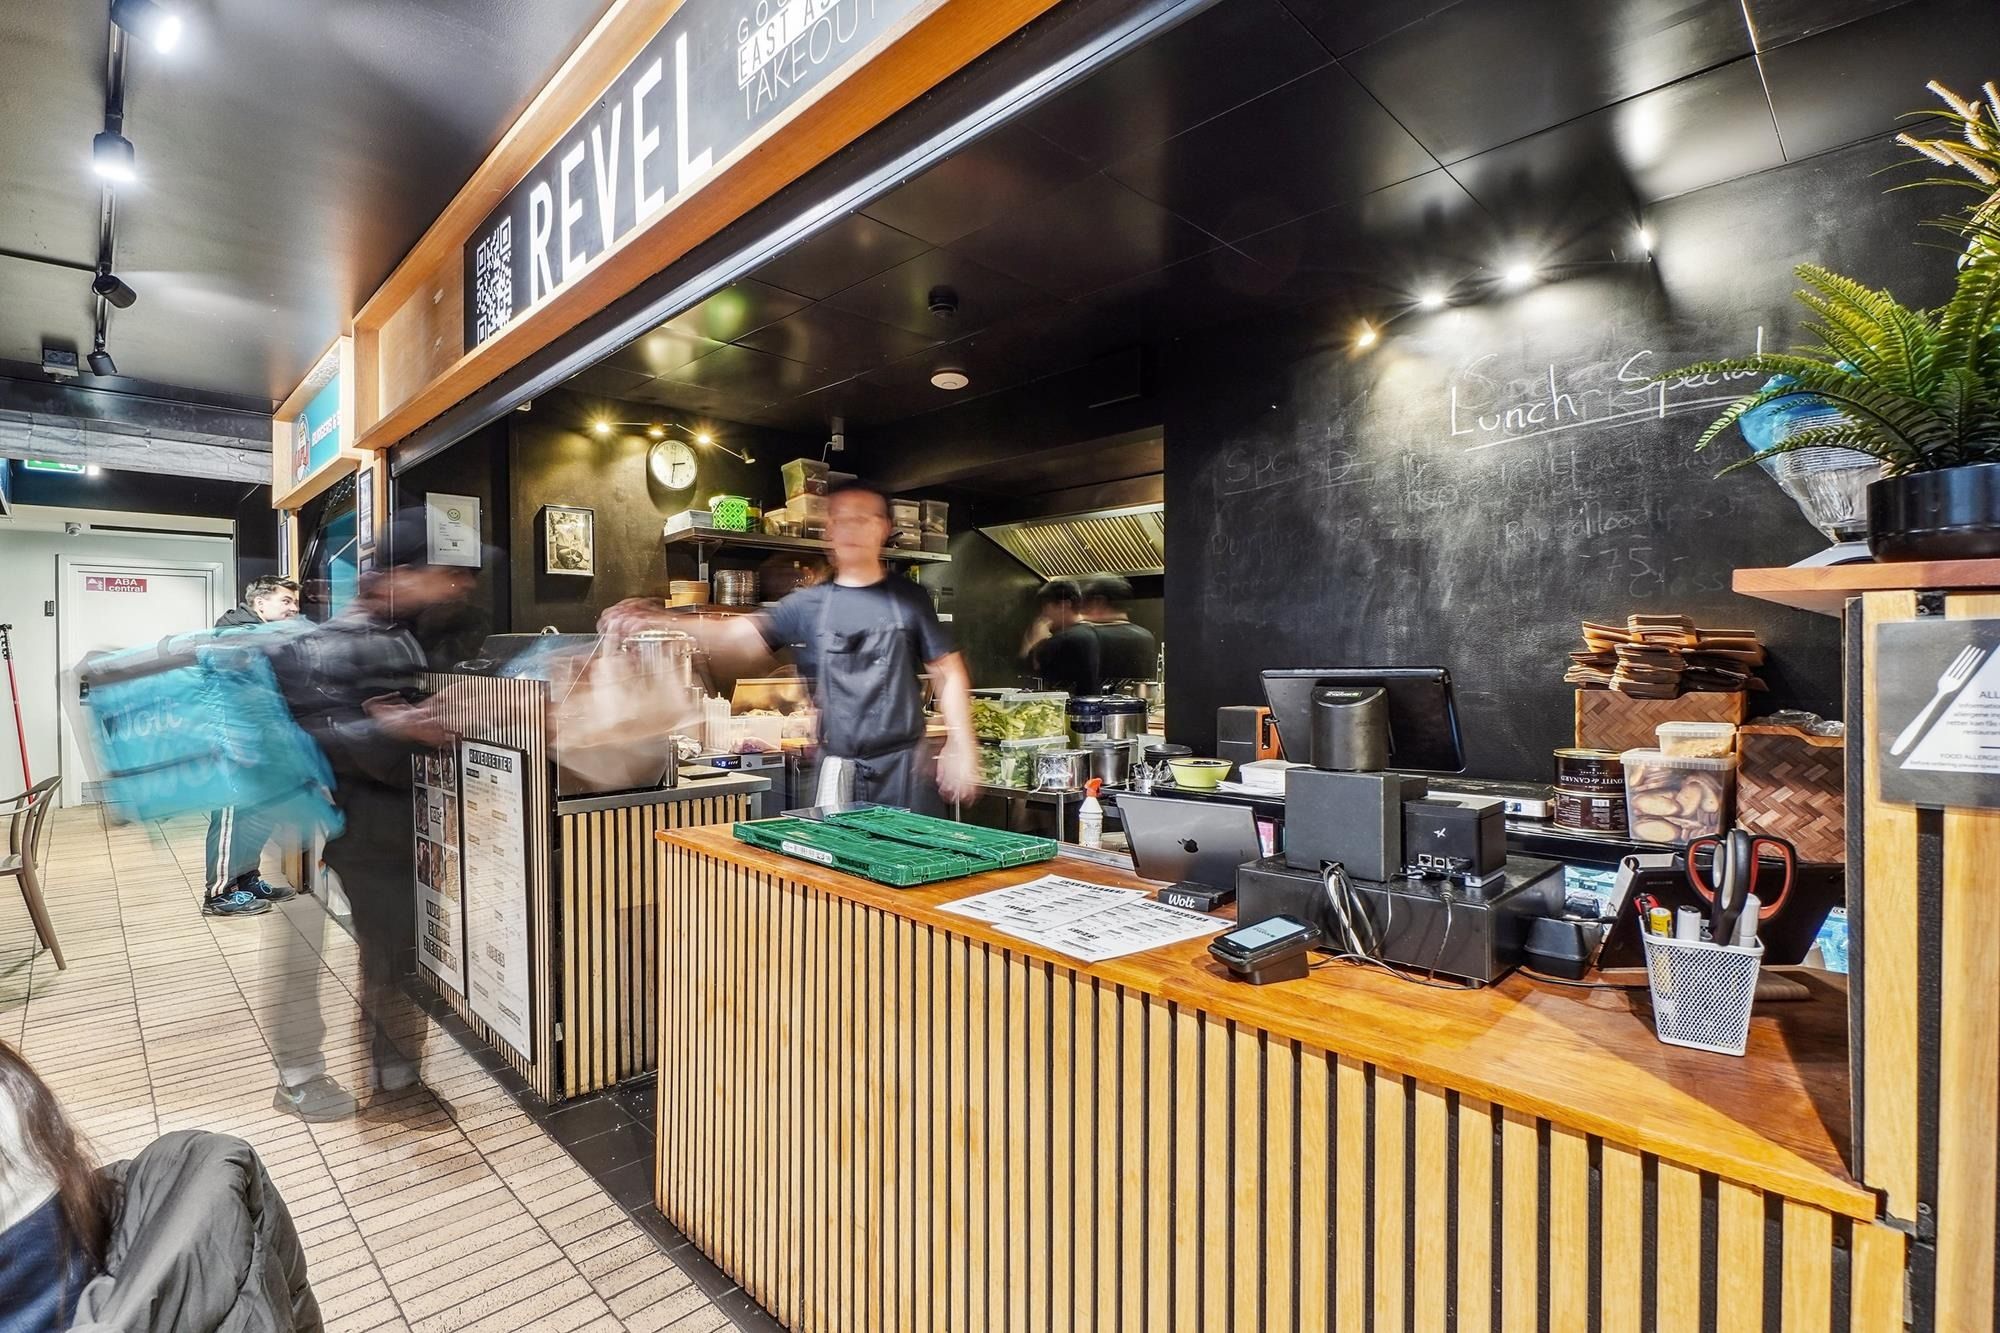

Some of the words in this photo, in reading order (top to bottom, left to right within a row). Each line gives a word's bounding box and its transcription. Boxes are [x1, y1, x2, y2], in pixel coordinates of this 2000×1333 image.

[738, 0, 790, 43] GO
[739, 9, 789, 79] EAST
[529, 33, 712, 307] REVEL
[1451, 363, 1577, 436] Lunch
[108, 585, 144, 593] central
[114, 578, 138, 586] ABA
[1561, 775, 1590, 784] CANARD
[1168, 894, 1196, 909] Wolt
